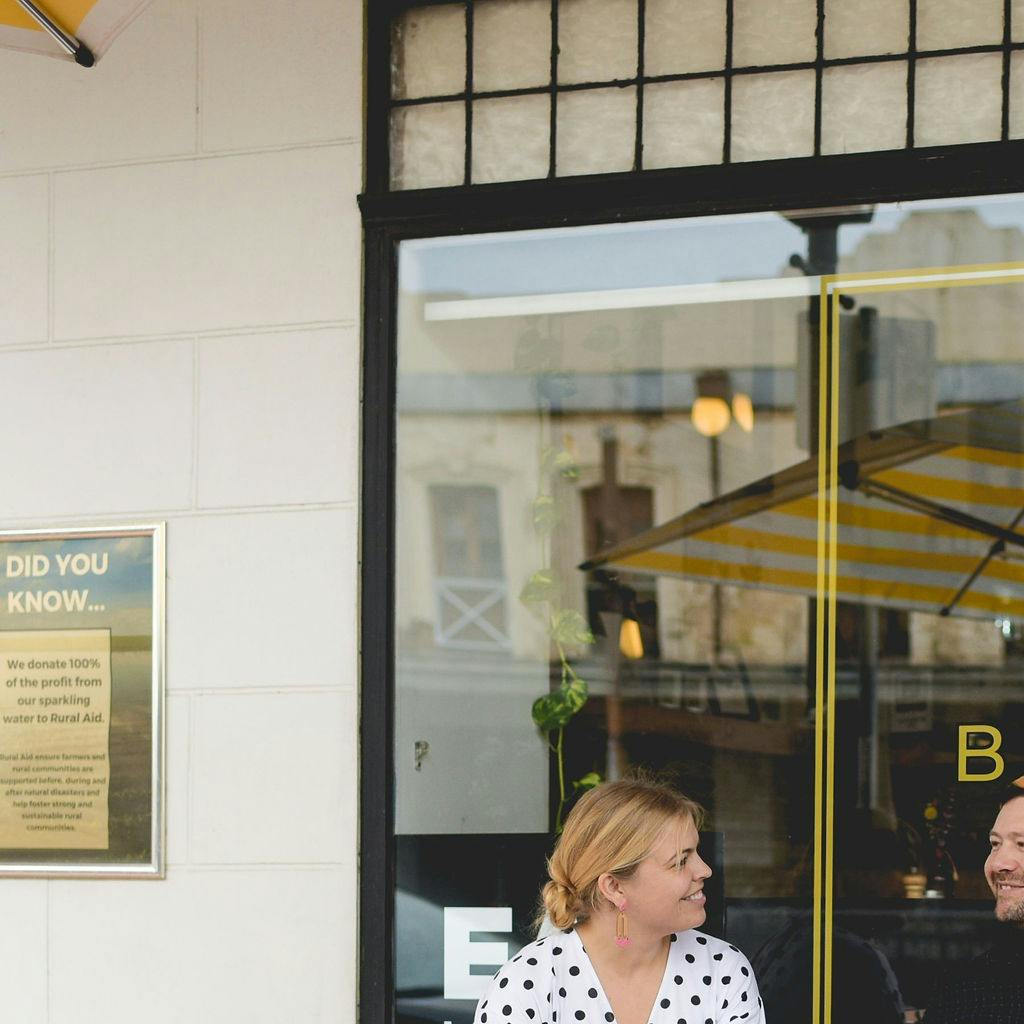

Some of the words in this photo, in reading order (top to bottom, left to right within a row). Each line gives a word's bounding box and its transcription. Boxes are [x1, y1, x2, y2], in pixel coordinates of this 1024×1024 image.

[6, 554, 50, 578] DID
[55, 552, 109, 576] YOU
[7, 589, 105, 613] KNOW...
[7, 659, 25, 669] We
[27, 659, 67, 669] donate
[69, 658, 101, 669] 100%
[6, 677, 17, 688] of
[20, 677, 38, 688] the
[41, 676, 73, 690] profit
[75, 676, 102, 687] from
[17, 697, 36, 706] our
[39, 695, 91, 708] sparkling
[3, 714, 34, 724] water
[37, 714, 48, 723] to
[50, 713, 80, 723] Rural
[82, 712, 105, 723] Aid.
